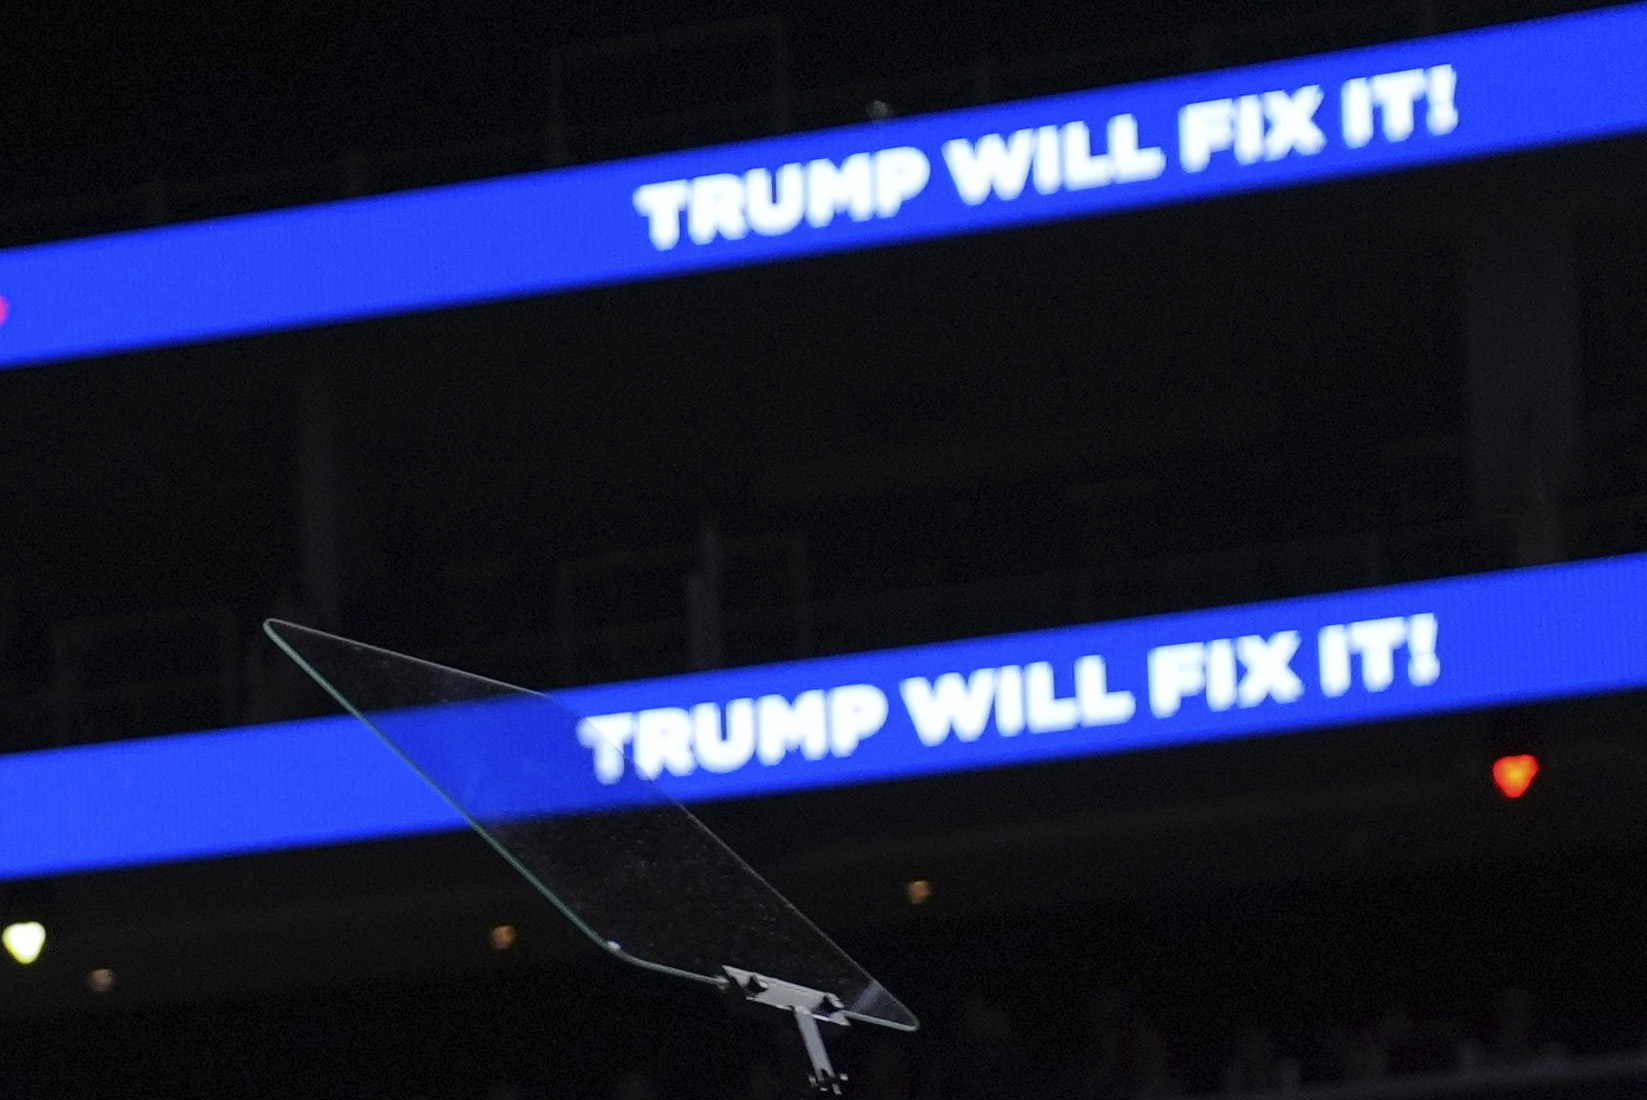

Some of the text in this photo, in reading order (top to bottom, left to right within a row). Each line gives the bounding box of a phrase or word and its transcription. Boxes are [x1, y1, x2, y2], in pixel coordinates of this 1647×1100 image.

[633, 65, 1458, 250] TRUMP WILL FIX IT!
[578, 613, 1440, 783] TRUMP WILL FIX IT!
